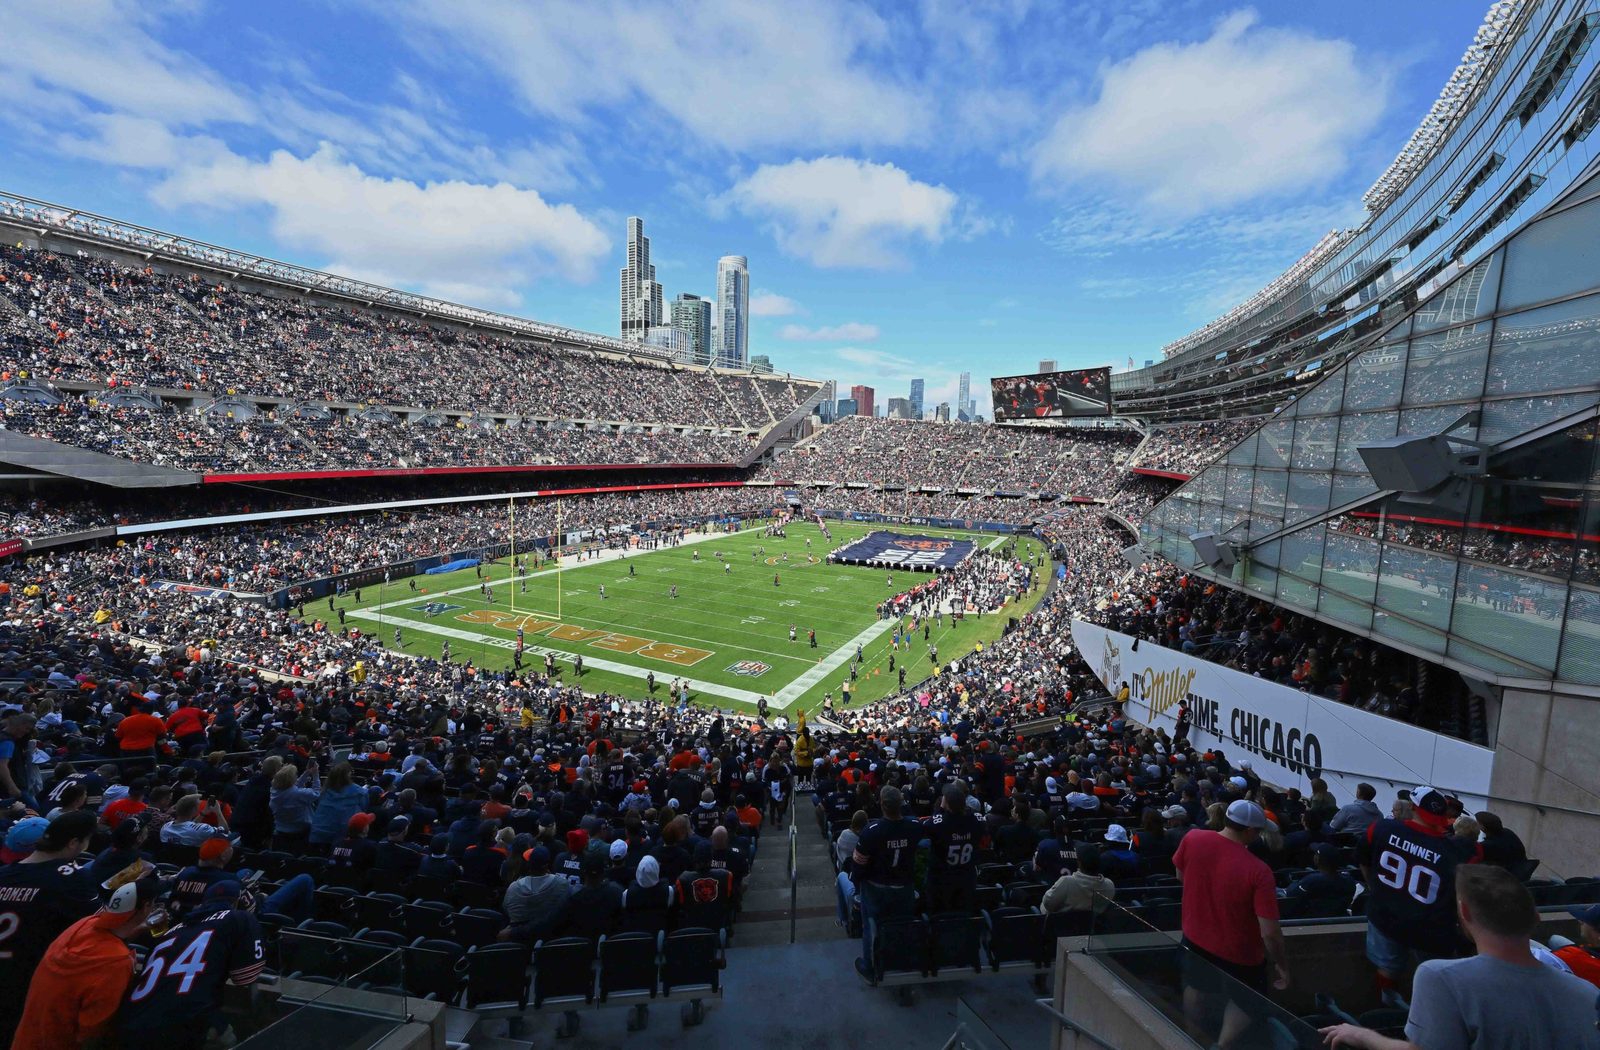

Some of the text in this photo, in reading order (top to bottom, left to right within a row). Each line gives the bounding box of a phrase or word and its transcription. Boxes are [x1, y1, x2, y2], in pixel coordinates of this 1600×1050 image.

[1141, 667, 1197, 724] Miller
[1231, 707, 1322, 780] CHICAGO
[608, 773, 624, 790] 34
[886, 839, 908, 849] FIELDS
[946, 843, 974, 866] 58
[1388, 834, 1441, 865] CLOWNEY
[177, 880, 208, 894] PAYTON
[1377, 850, 1441, 905] 90
[129, 930, 216, 1003] 54
